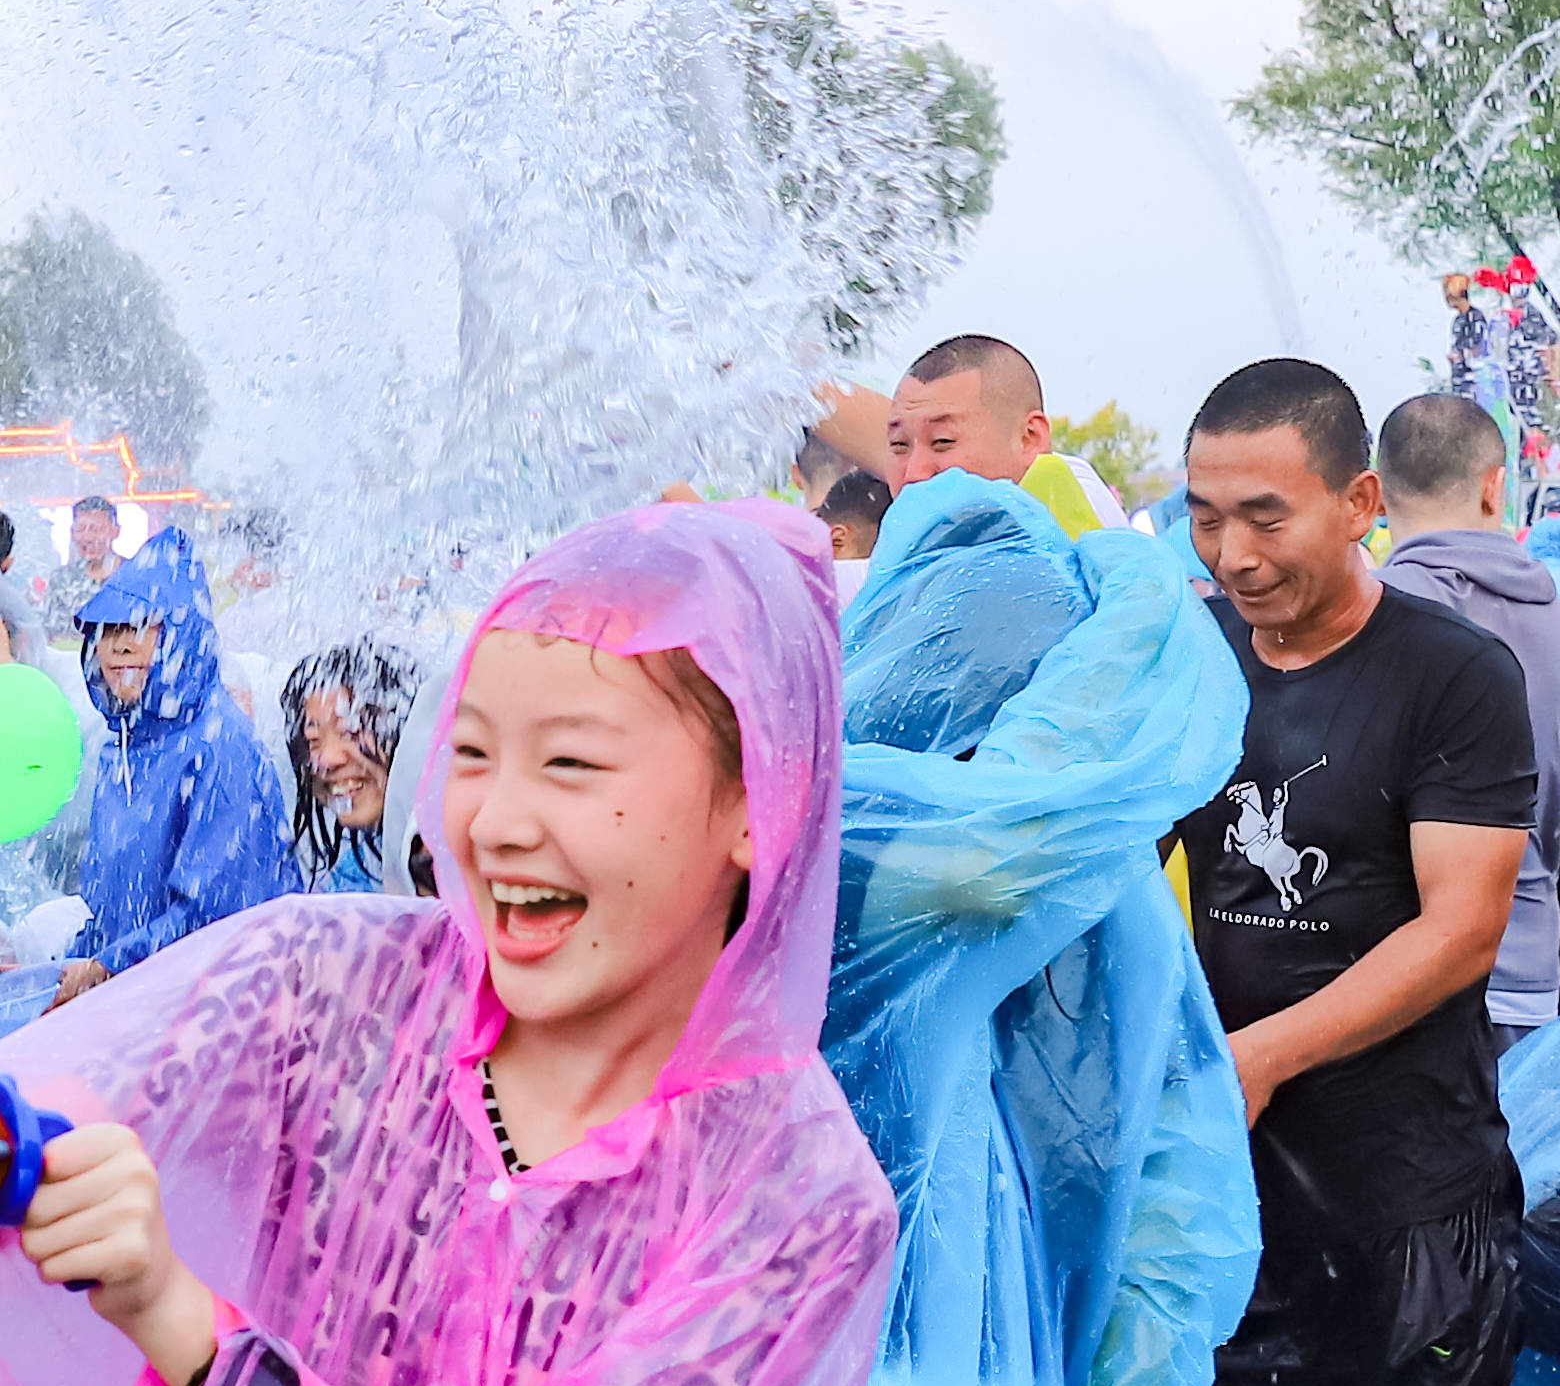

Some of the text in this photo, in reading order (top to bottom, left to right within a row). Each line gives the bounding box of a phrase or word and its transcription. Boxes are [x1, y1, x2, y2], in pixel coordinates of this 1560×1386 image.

[1209, 907, 1330, 932] LA ELDORADO POLO
